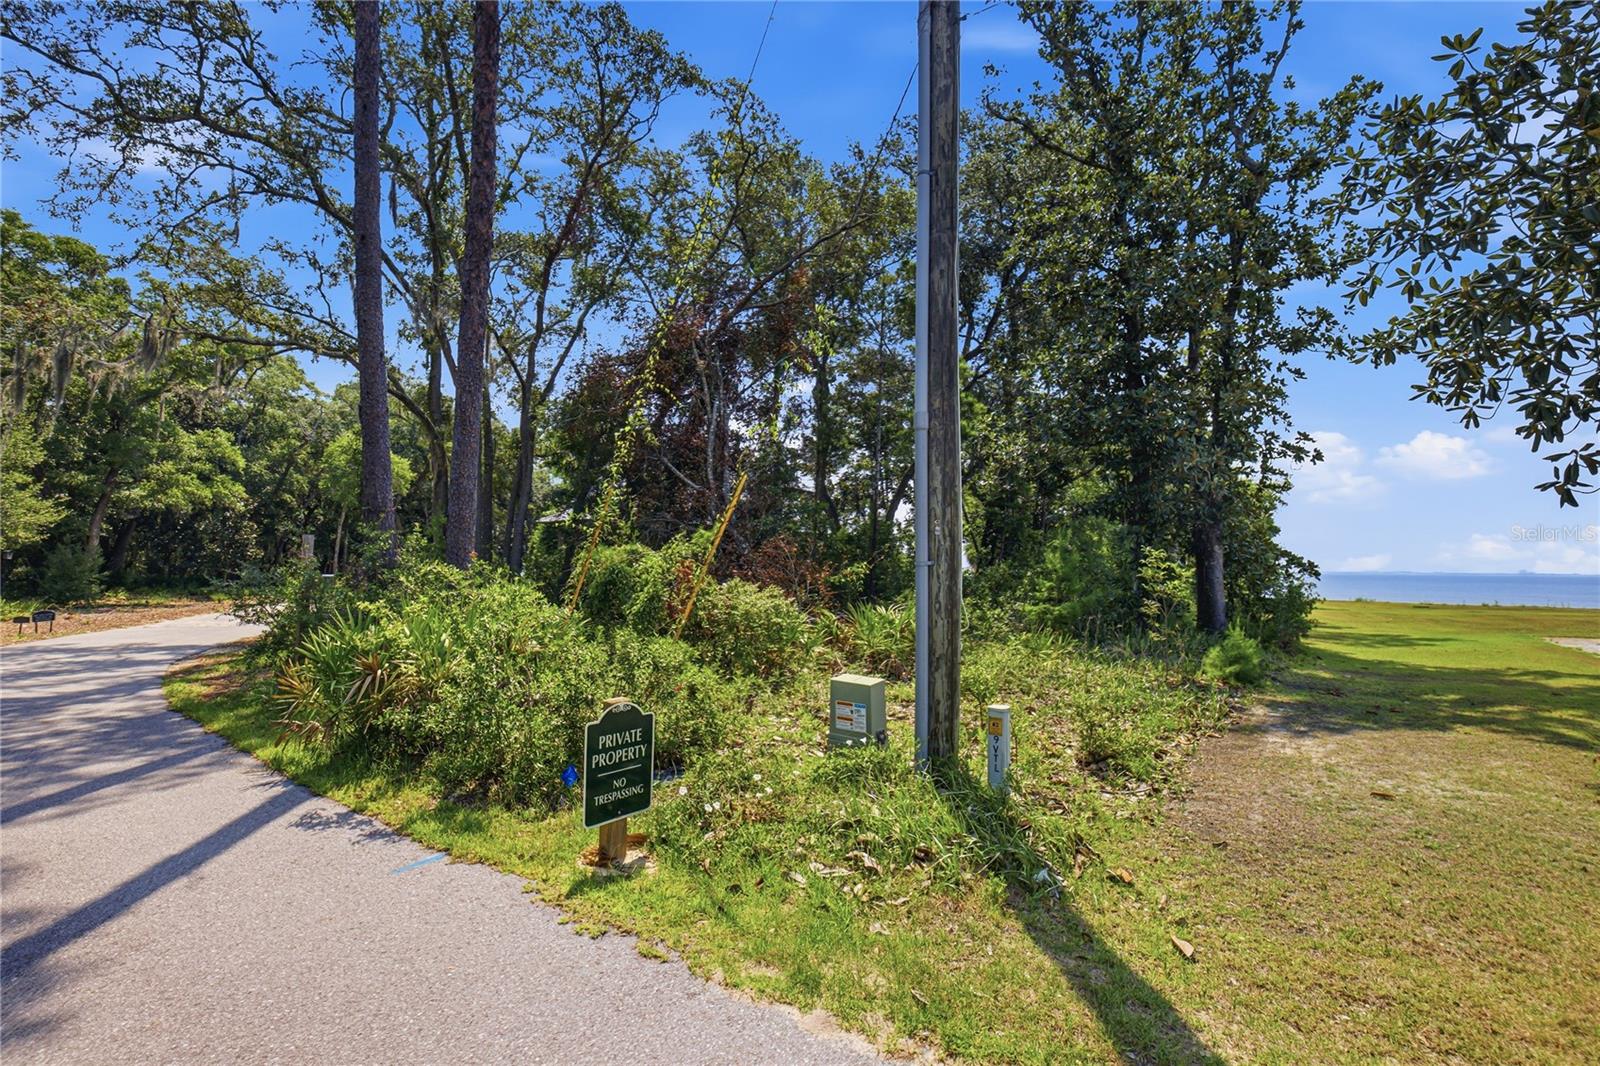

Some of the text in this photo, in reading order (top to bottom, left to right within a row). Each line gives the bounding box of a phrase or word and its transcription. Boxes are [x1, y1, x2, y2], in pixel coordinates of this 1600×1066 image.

[599, 728, 643, 750] PRIVATE
[591, 744, 648, 769] PROPERTY
[612, 777, 627, 789] NO
[593, 783, 645, 807] TRESPASSING
